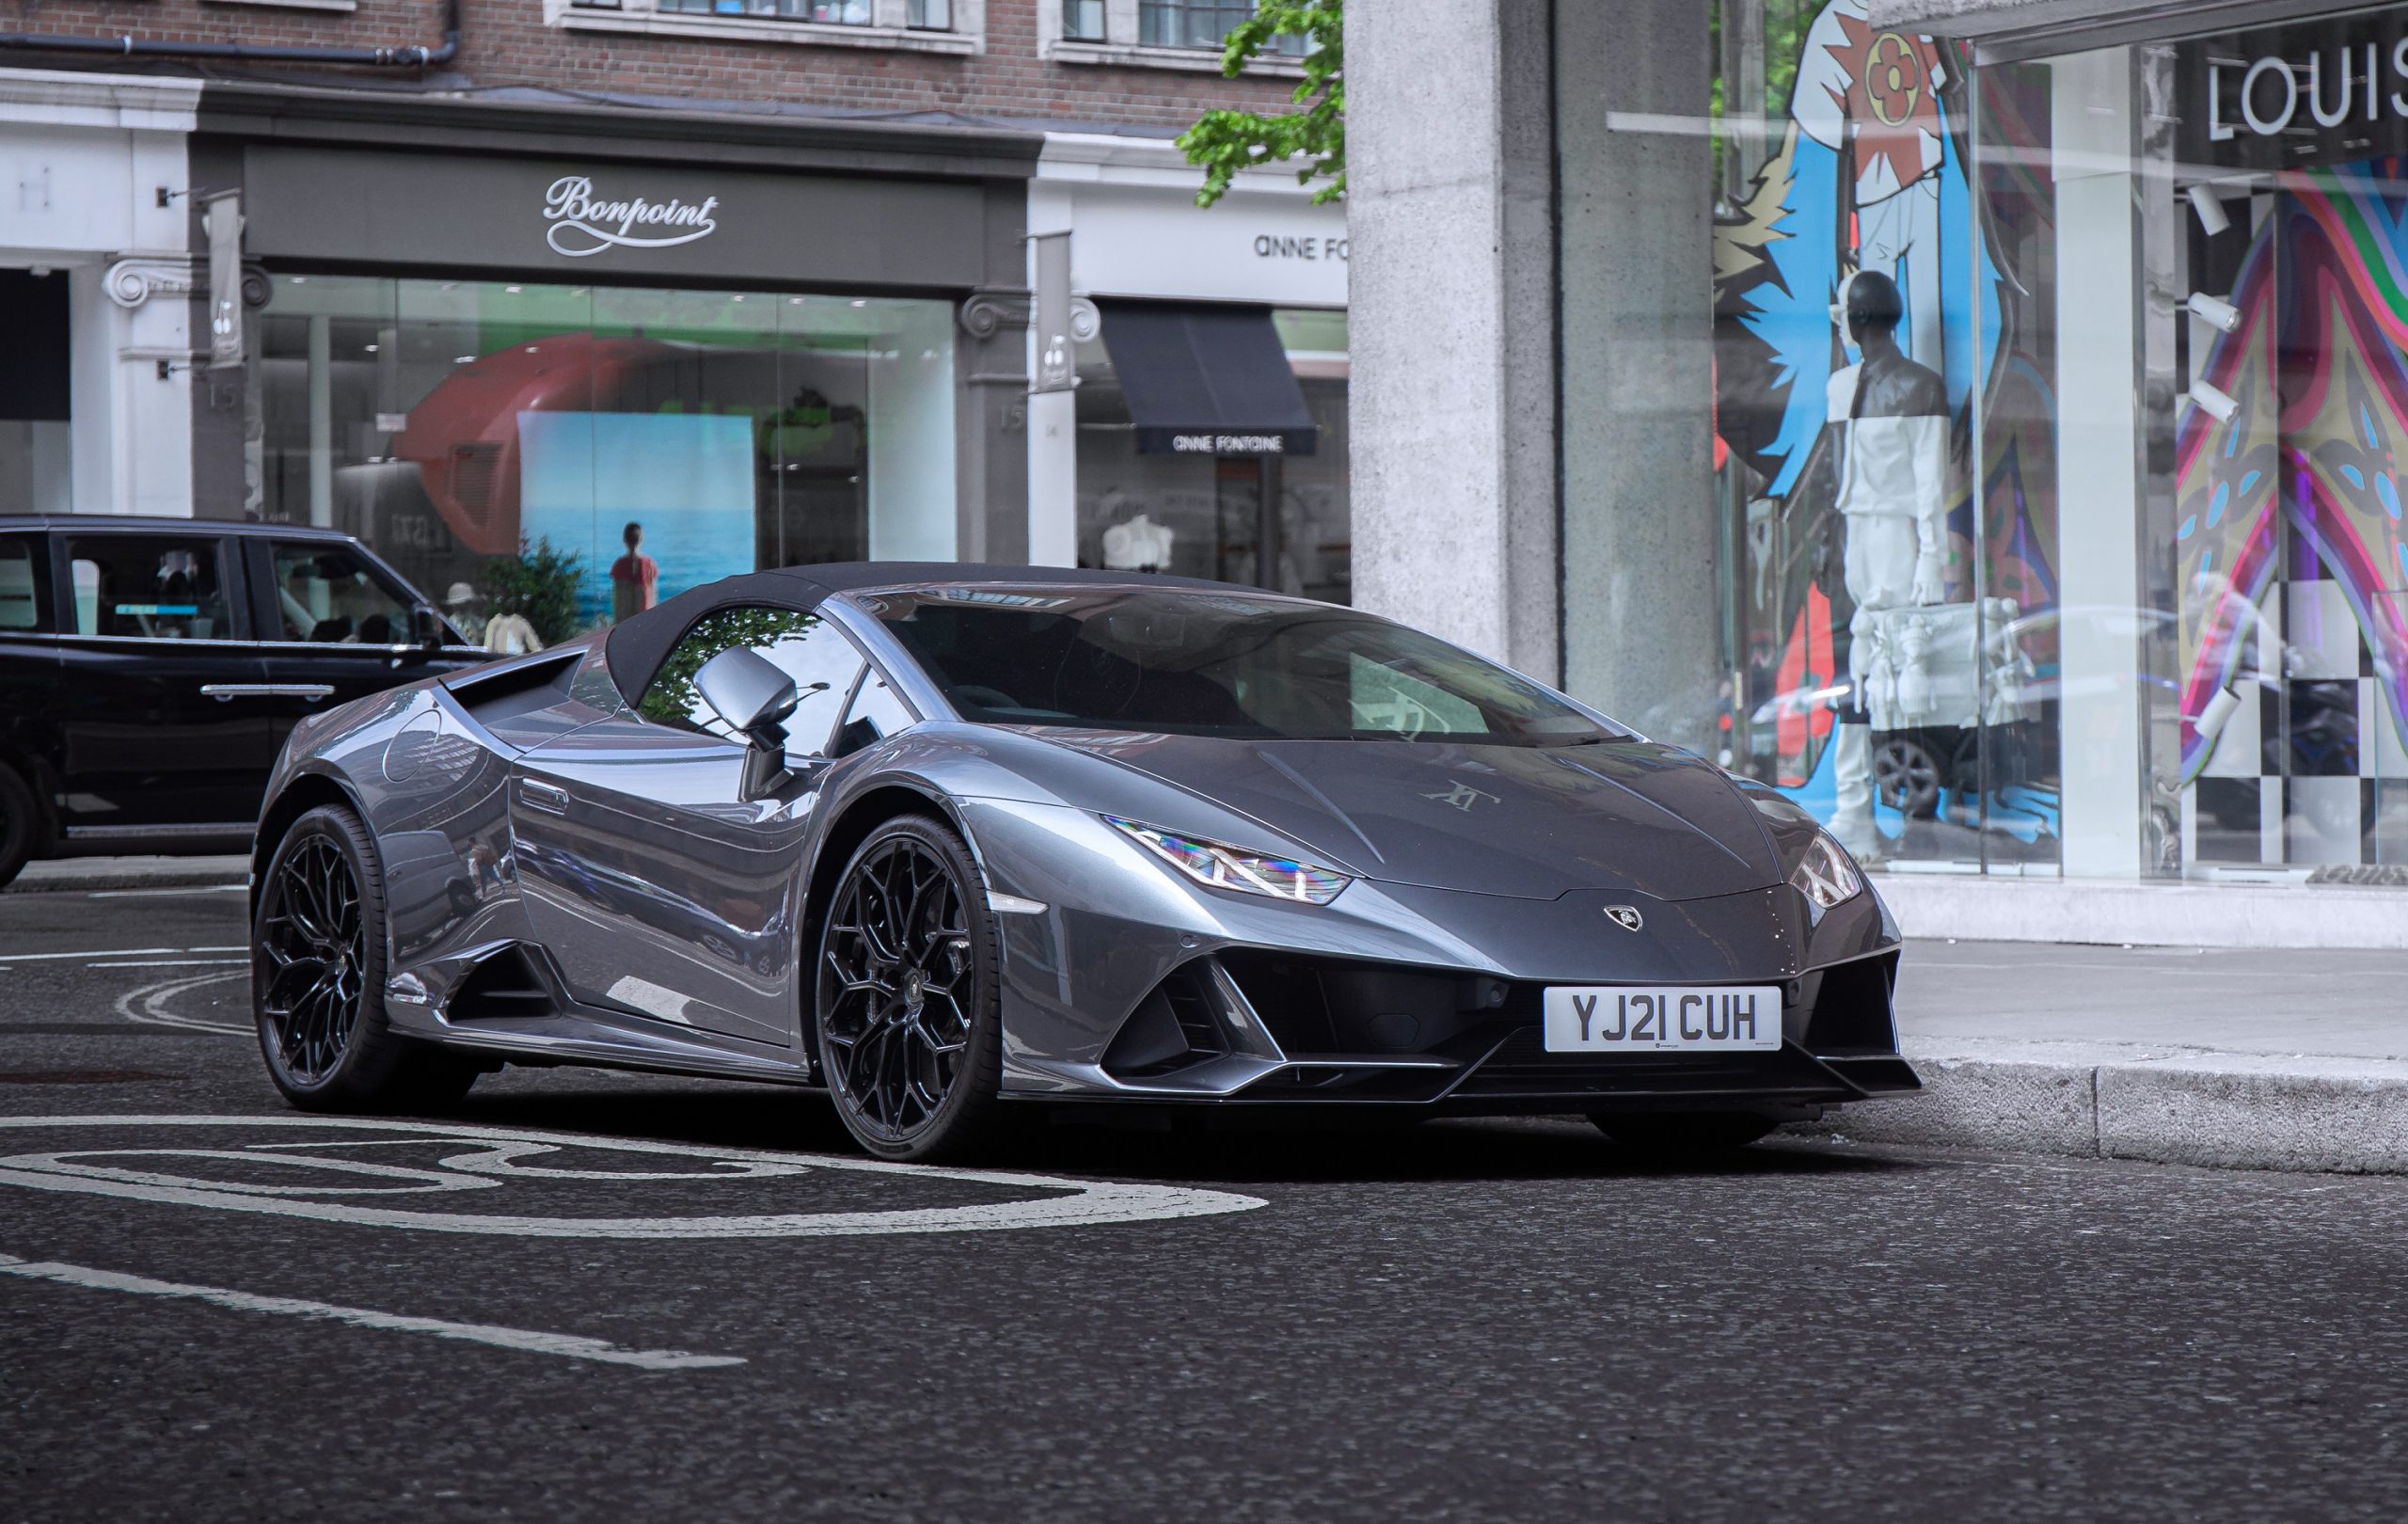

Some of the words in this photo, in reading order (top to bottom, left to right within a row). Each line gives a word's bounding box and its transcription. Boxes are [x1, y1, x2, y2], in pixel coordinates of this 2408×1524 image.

[543, 176, 719, 256] Bonpoint
[1572, 994, 1666, 1040] YJ21
[1679, 994, 1756, 1040] CUH
